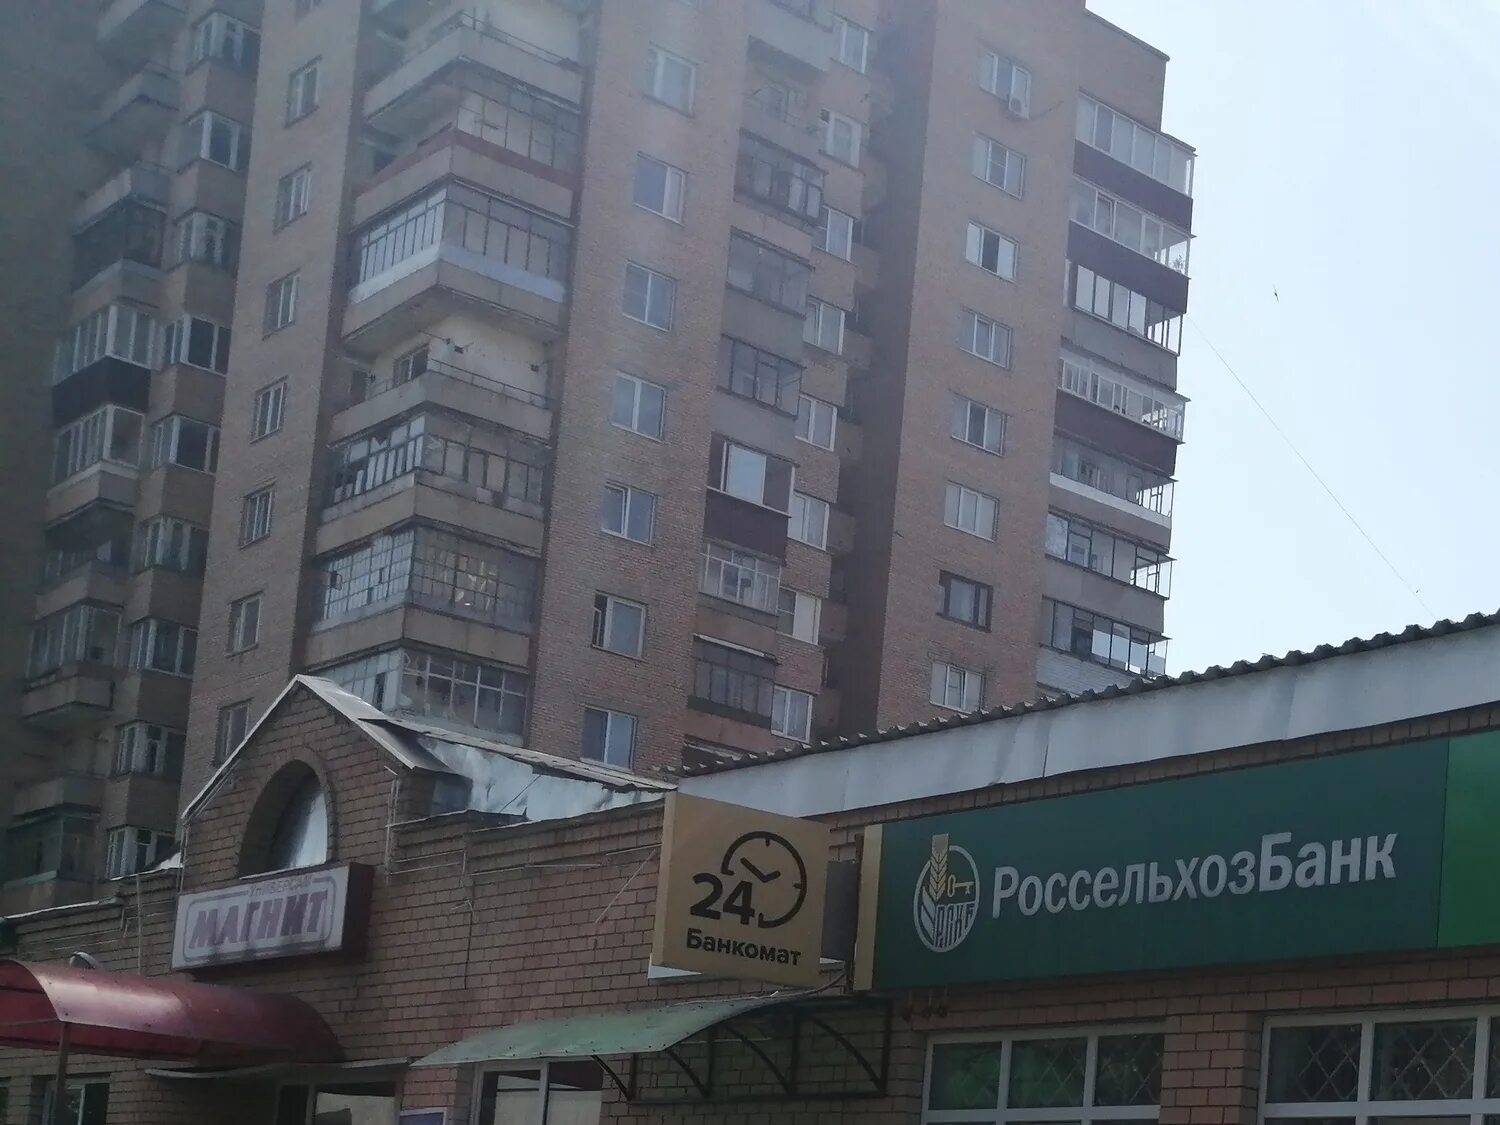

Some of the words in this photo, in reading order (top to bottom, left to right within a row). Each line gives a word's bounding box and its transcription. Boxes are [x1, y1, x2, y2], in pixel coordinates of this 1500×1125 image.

[689, 872, 756, 926] 24
[992, 831, 1399, 919] РоссельхозБанк
[188, 889, 329, 949] МАГНИТ
[686, 926, 802, 967] Банкомат
